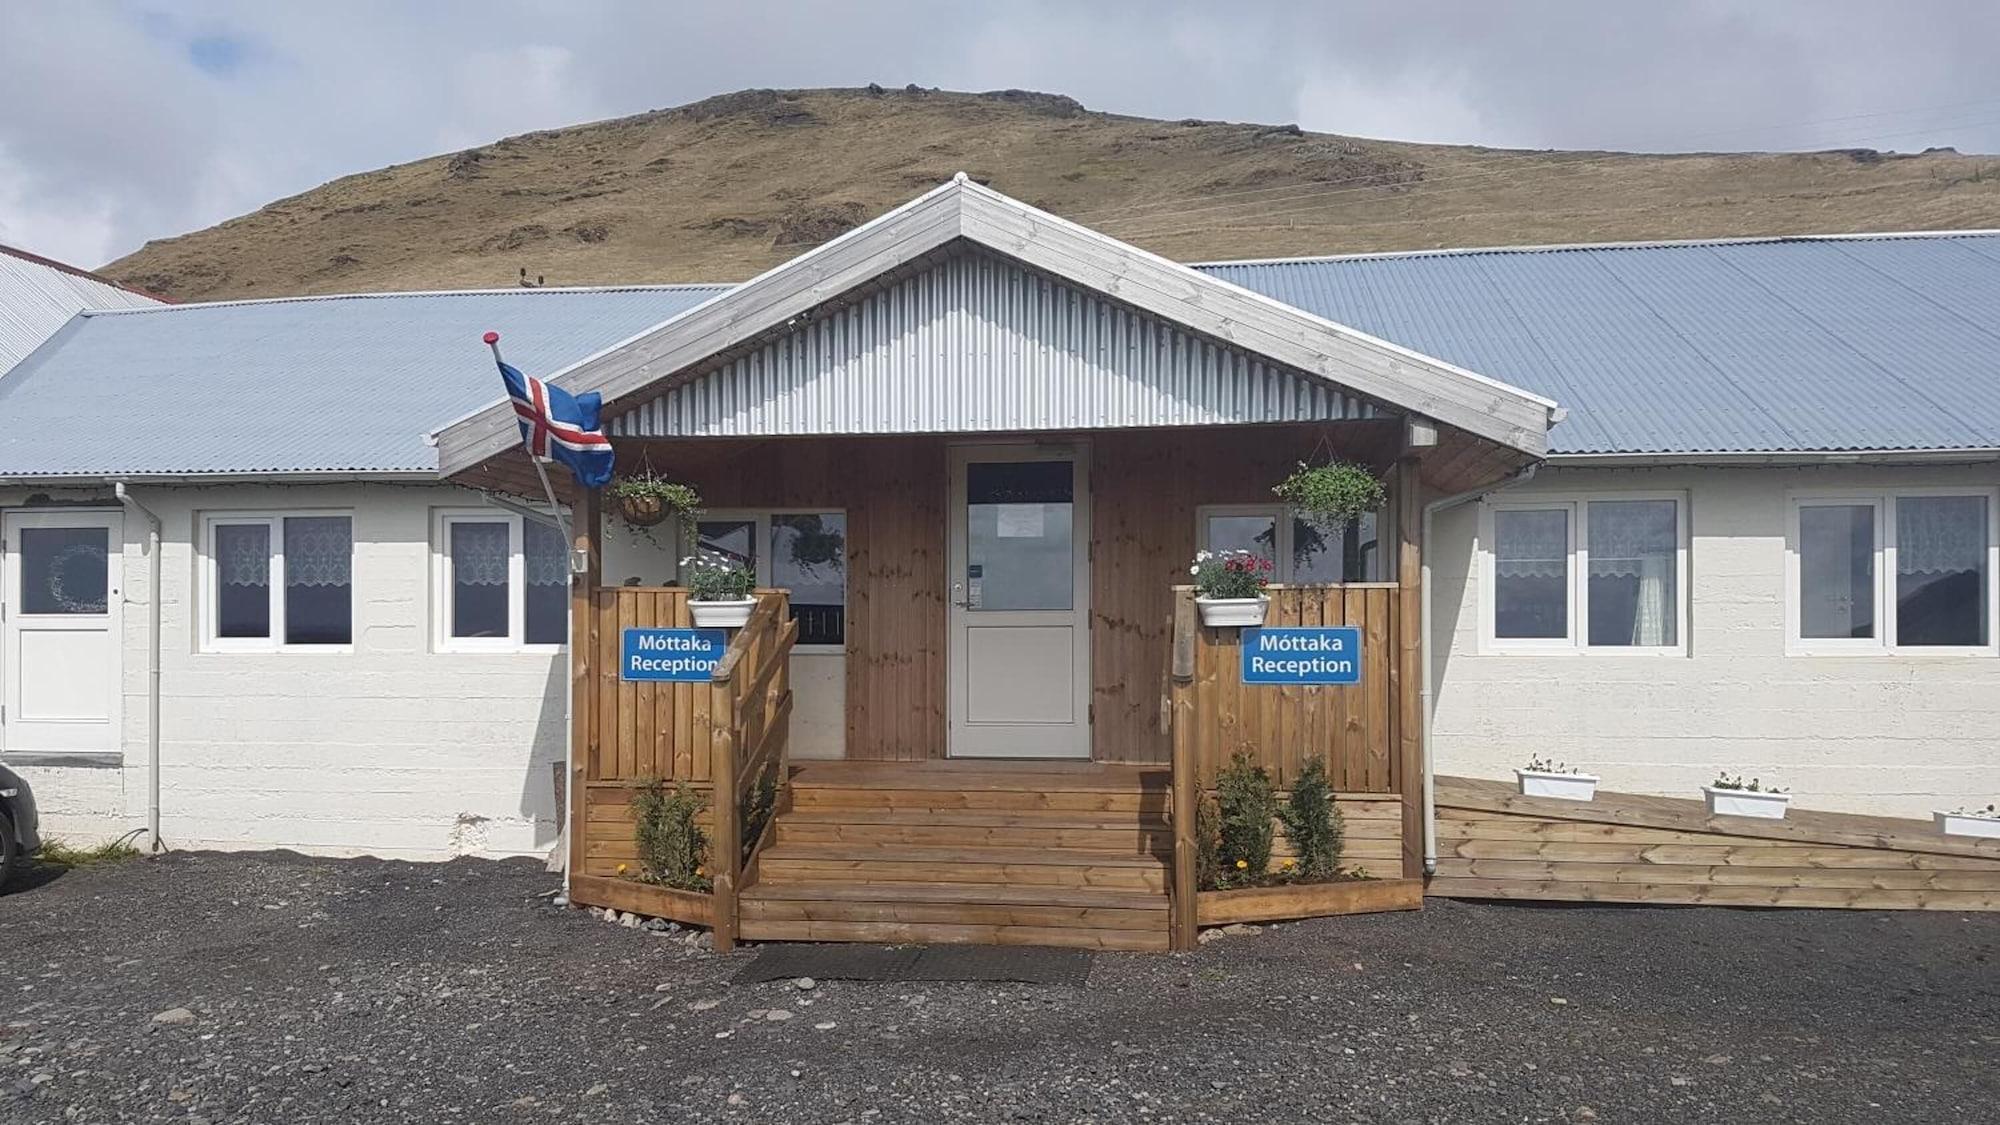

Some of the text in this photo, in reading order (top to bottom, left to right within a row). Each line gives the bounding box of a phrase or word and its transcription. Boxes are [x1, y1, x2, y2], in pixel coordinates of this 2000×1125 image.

[639, 634, 711, 652] Móttaka
[1260, 634, 1343, 651] Móttaka
[631, 655, 718, 675] Reception
[1252, 656, 1352, 677] Reception
